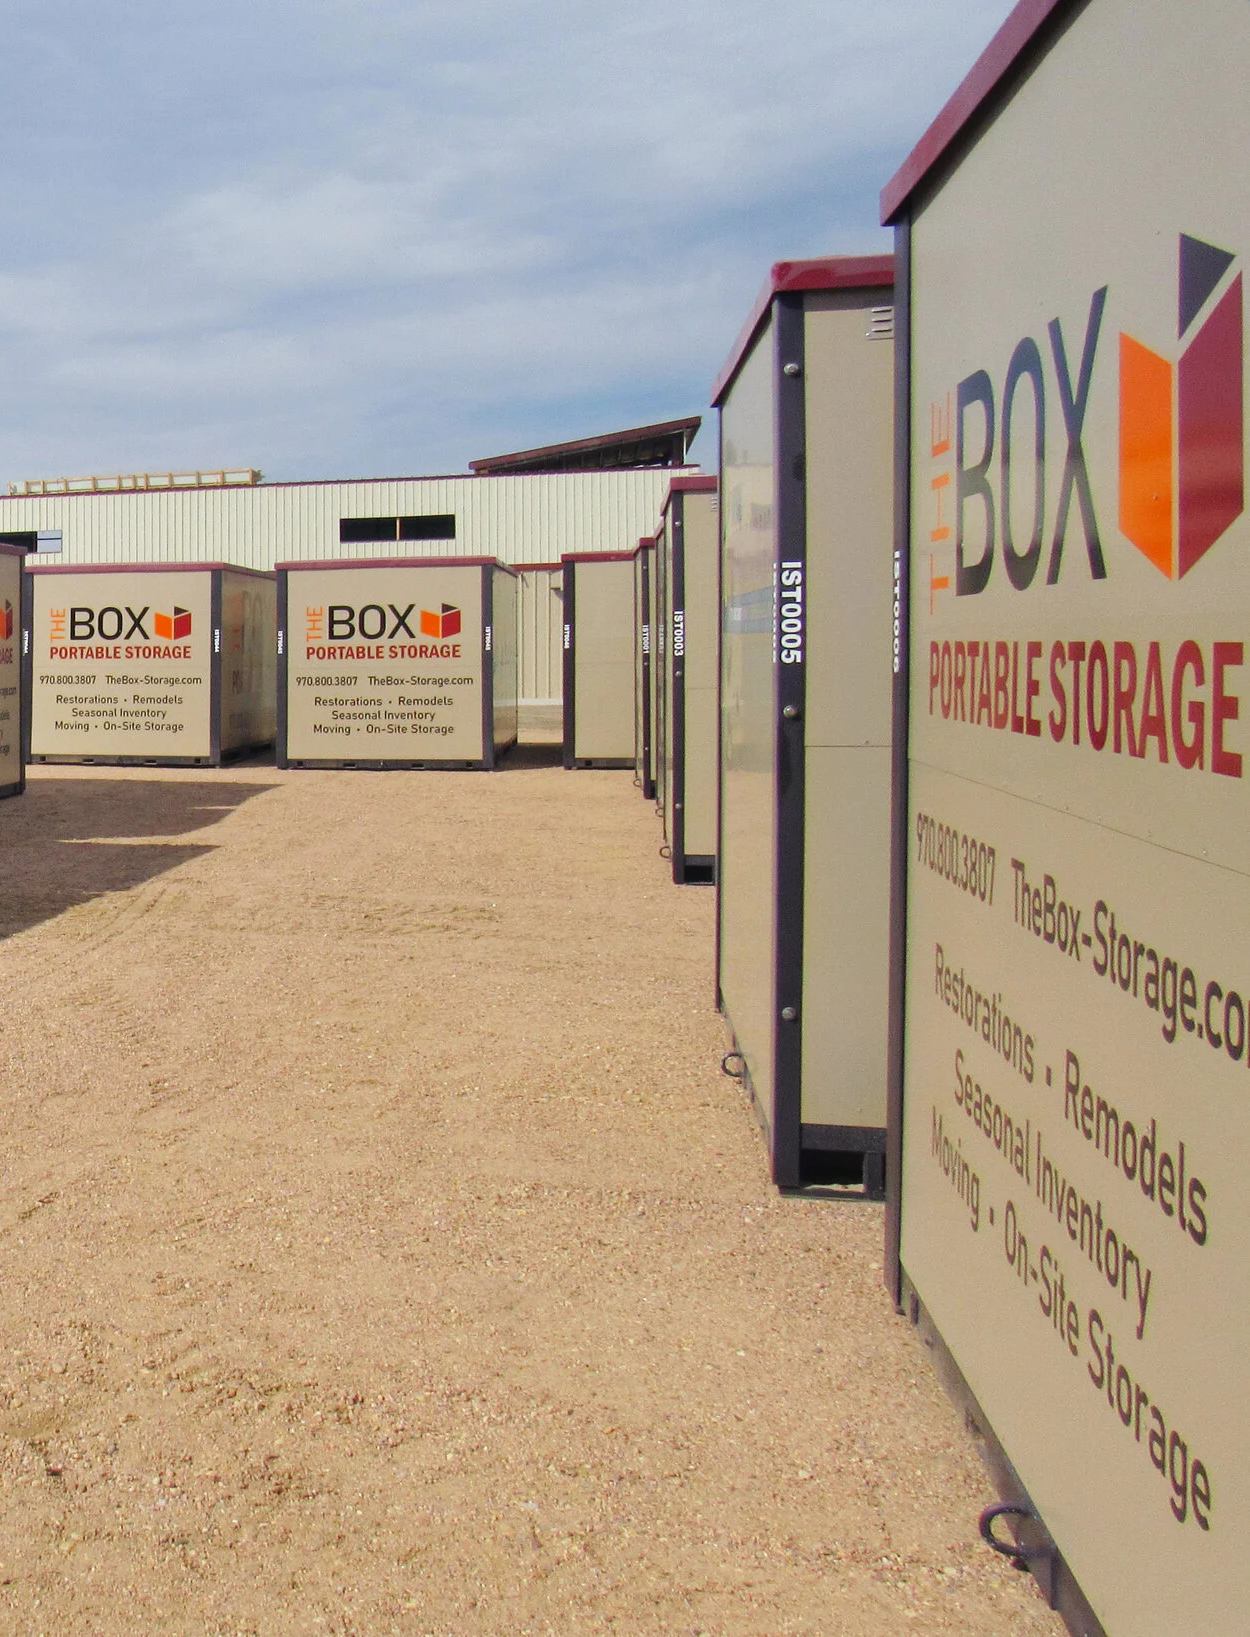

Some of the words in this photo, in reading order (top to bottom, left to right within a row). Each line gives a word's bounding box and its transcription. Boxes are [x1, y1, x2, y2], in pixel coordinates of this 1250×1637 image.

[930, 391, 950, 616] THE
[956, 285, 1108, 597] BOX
[50, 608, 66, 642] THE
[70, 606, 150, 641] BOX
[306, 606, 323, 642] THE
[328, 604, 416, 640] BOX
[781, 561, 802, 664] IST0005
[674, 611, 684, 656] IST0003
[50, 646, 121, 660] PORTABLE
[125, 645, 192, 660] STORAGE
[306, 646, 384, 660] PORTABLE
[388, 644, 461, 659] STORAGE
[39, 675, 96, 685] 970.800.3807
[105, 675, 202, 687] TheBox-Storage.com
[296, 676, 358, 686] 970.800.3807
[367, 675, 474, 688] TheBox-Storage.com
[56, 694, 119, 704] Restorations
[132, 694, 183, 705] Remodels
[314, 696, 383, 707] Restorations
[398, 695, 453, 706] Remodels
[929, 640, 1043, 738] PORTABLE
[1048, 639, 1243, 779] STORAGE
[55, 720, 90, 733] Moving
[103, 721, 141, 731] On-Site
[144, 721, 184, 733] Storage
[71, 708, 117, 718] Seasonal
[120, 708, 167, 720] Inventory
[331, 710, 381, 720] Seasonal
[384, 710, 436, 722] Inventory
[313, 724, 351, 736] Moving
[366, 724, 408, 734] On-Site
[410, 724, 454, 736] Storage
[917, 812, 995, 906] 970.800.3807
[1011, 857, 1250, 1069] TheBox-Storage.co
[935, 942, 1034, 1083] Restorations
[1065, 1049, 1207, 1246] Remodels
[954, 1048, 1030, 1186] Seasonal
[1036, 1130, 1151, 1340] Inventory
[932, 1105, 980, 1232] Moving
[1005, 1200, 1079, 1356] On-Site
[1088, 1309, 1210, 1531] Storage
